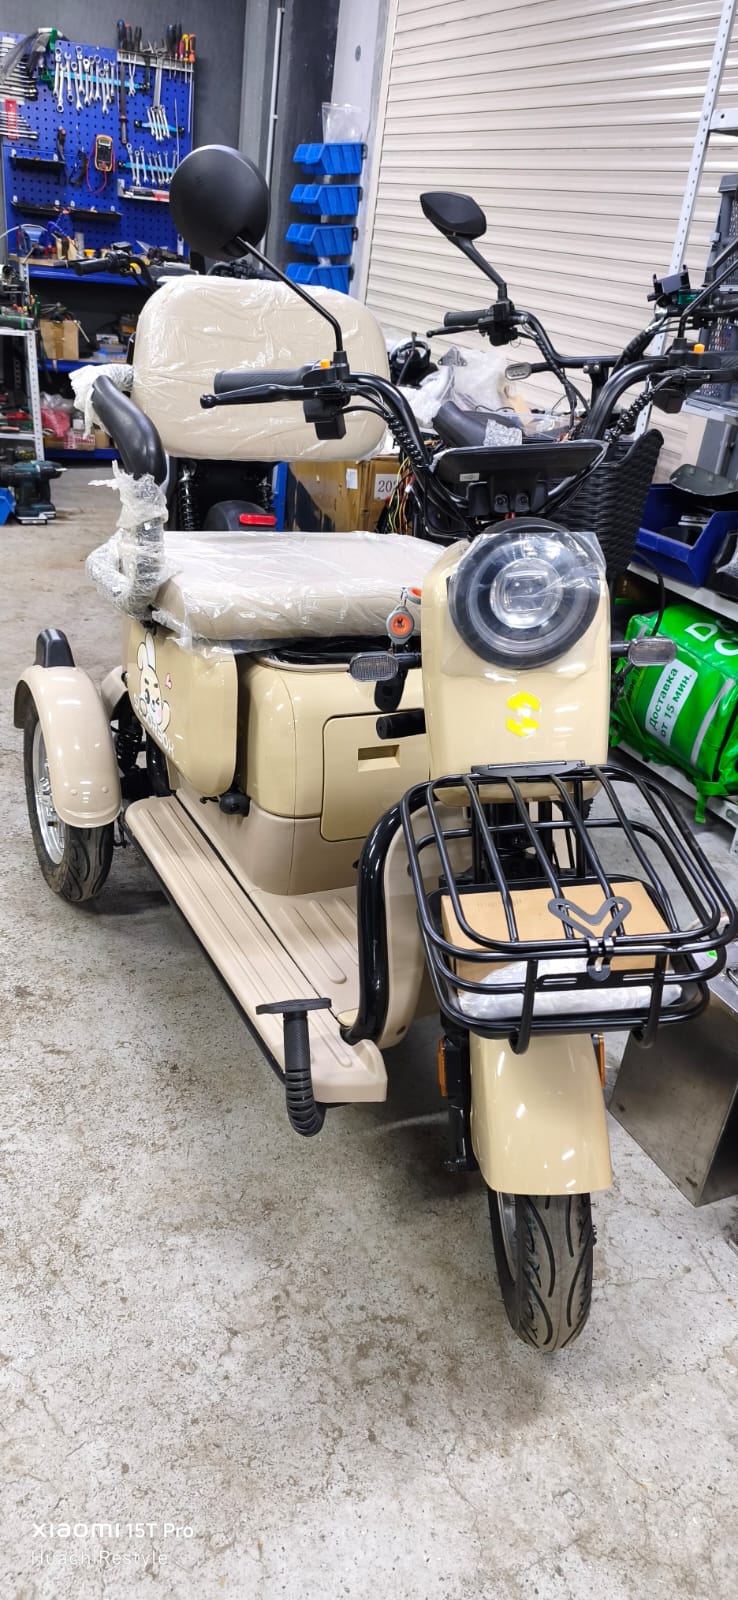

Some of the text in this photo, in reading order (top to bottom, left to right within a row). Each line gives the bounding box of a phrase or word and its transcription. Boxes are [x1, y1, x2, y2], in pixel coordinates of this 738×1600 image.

[378, 480, 397, 493] 20
[649, 667, 678, 731] Доставка
[661, 674, 692, 738] от 15 мин.
